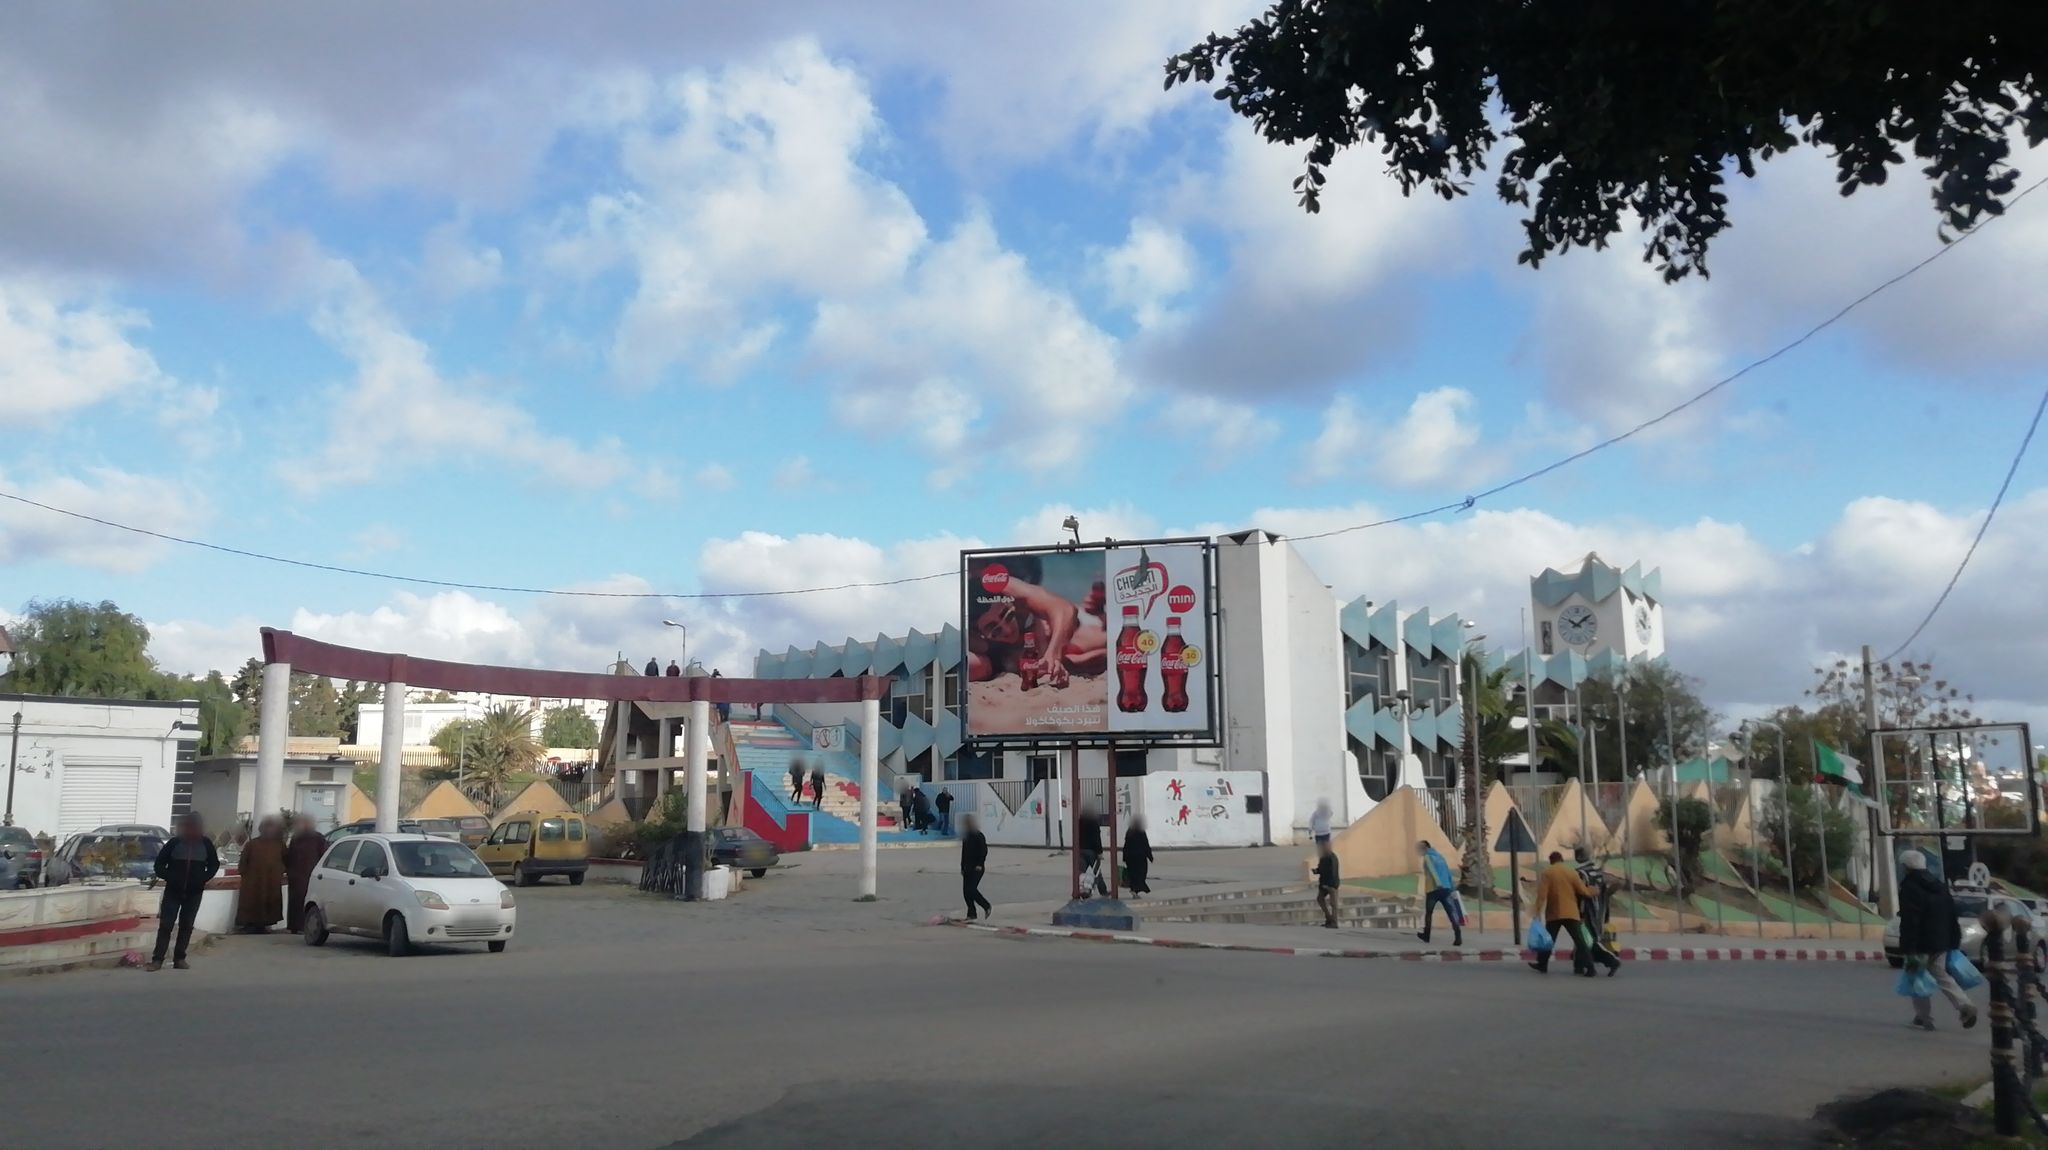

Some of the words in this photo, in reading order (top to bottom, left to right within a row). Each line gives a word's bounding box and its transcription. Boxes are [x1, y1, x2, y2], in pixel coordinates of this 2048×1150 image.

[982, 572, 1008, 584] Coca-Cola
[1119, 583, 1158, 600] الجديدة
[1169, 594, 1194, 604] mini
